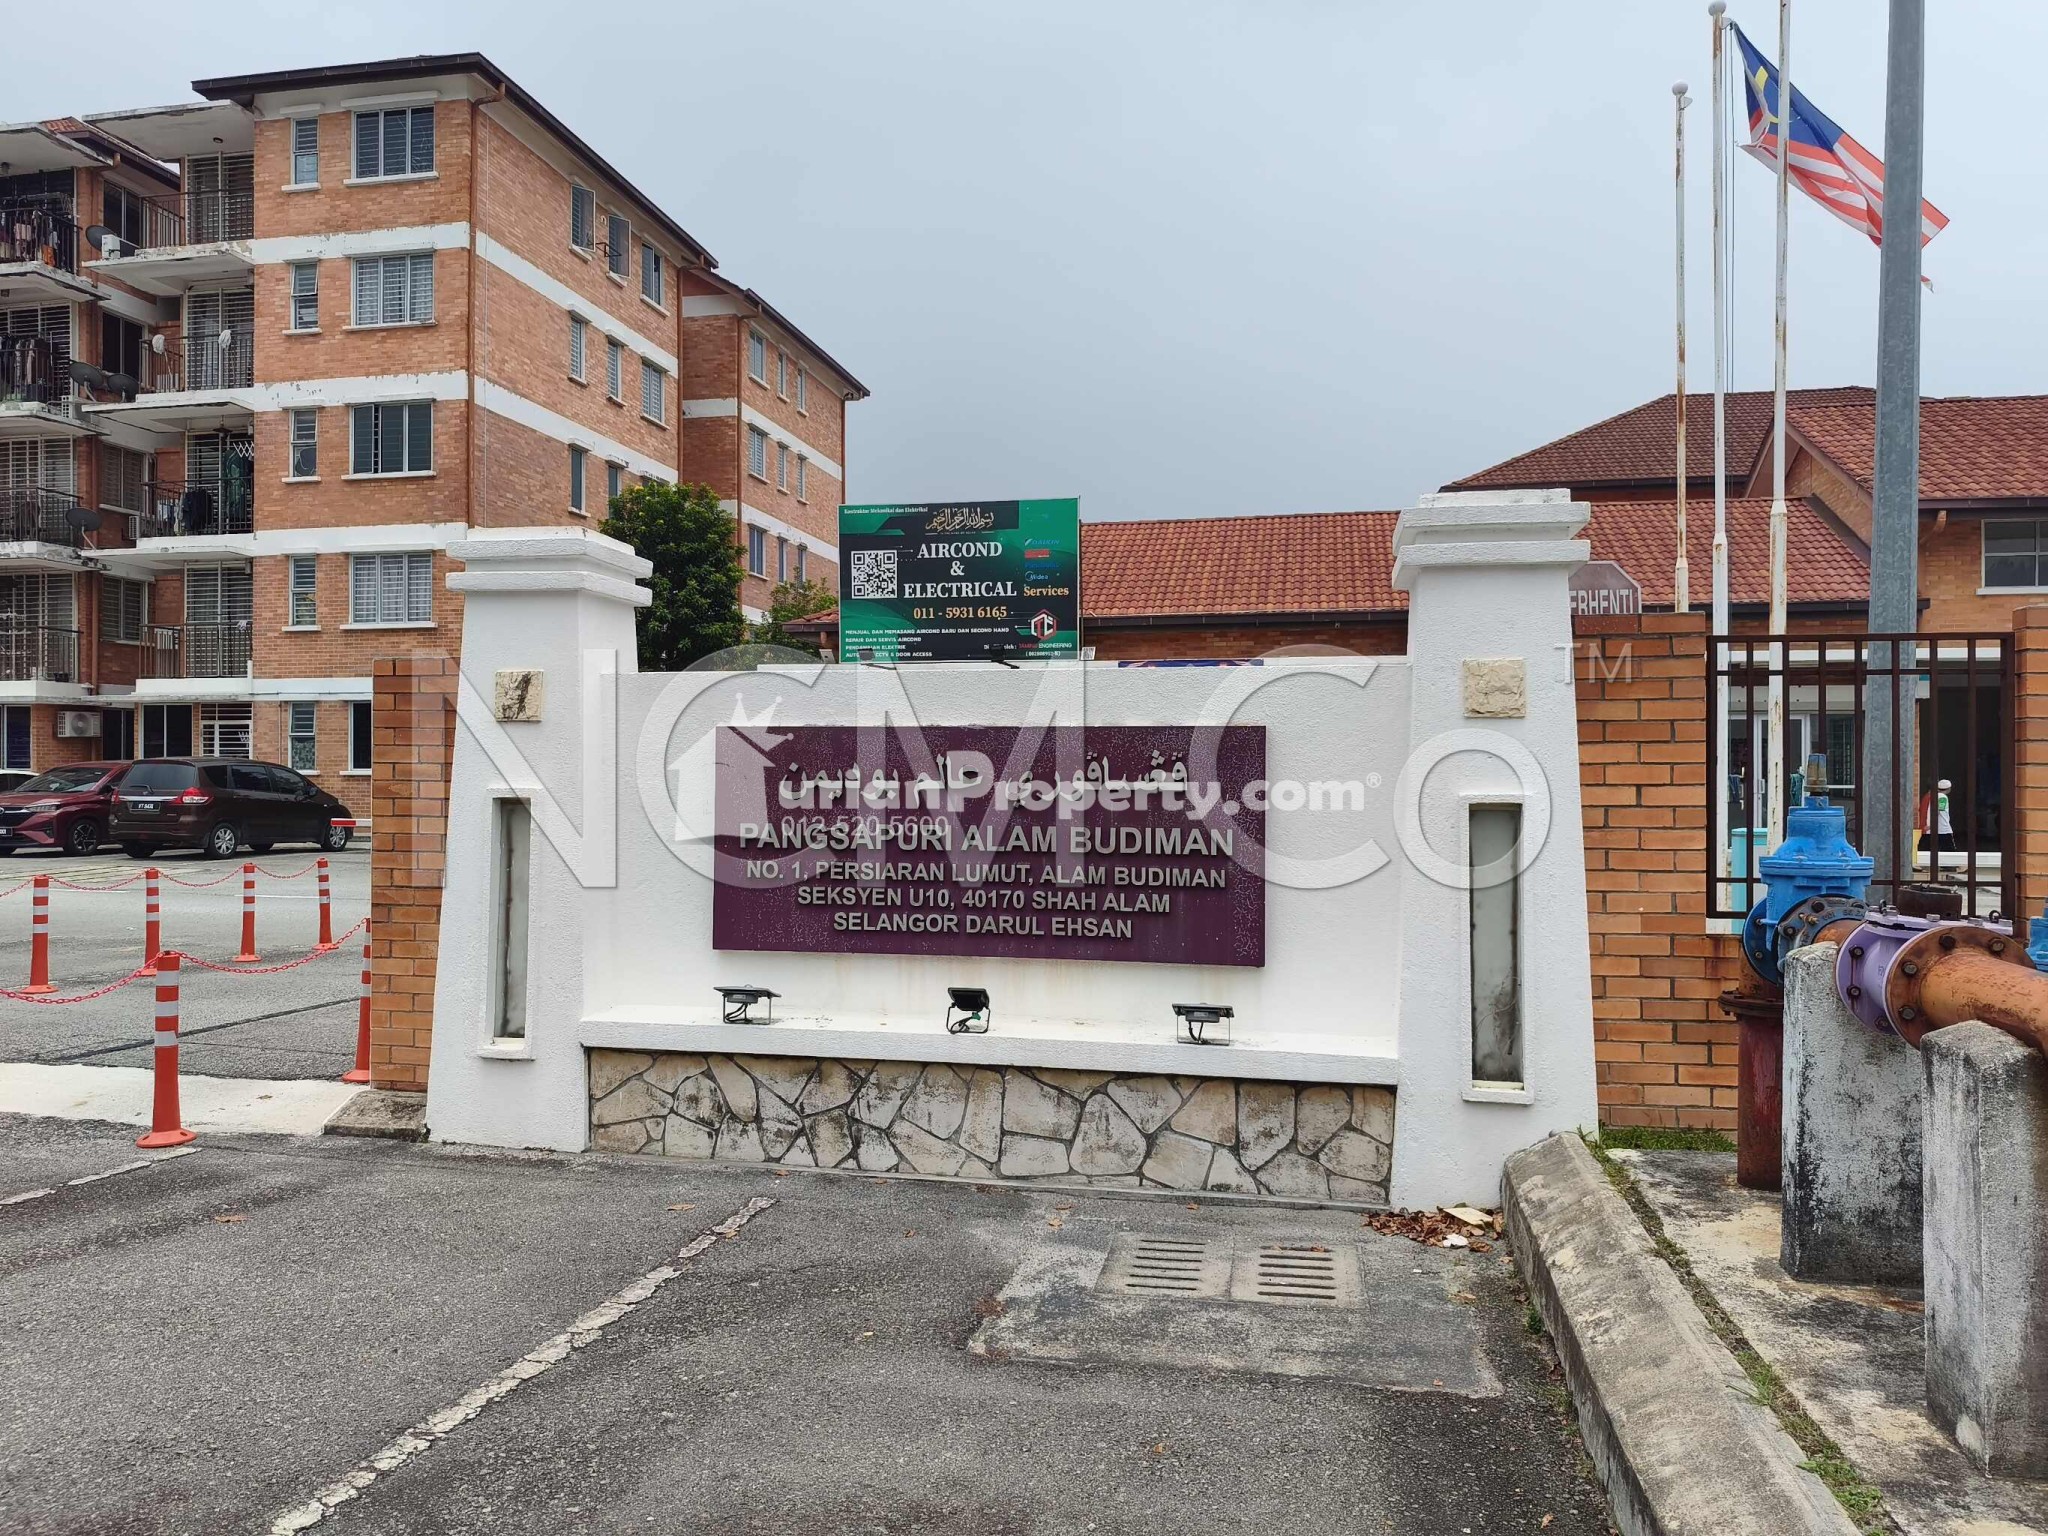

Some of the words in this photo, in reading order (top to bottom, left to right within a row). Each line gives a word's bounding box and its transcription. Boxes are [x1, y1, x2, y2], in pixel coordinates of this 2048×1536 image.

[917, 541, 1003, 559] AIRCOND
[950, 560, 965, 576] &
[903, 581, 1018, 599] ELECTRICAL
[1023, 585, 1069, 597] Services
[913, 607, 935, 619] 011
[946, 606, 975, 619] 5931
[977, 605, 1008, 618] 6165
[1568, 588, 1634, 615] ERHENTI
[739, 822, 951, 851] PANGSAPURI
[961, 824, 1056, 852] ALAM
[1070, 826, 1233, 856] BUDIMAN
[747, 860, 784, 879] NO.
[792, 861, 808, 881] 1,
[815, 861, 944, 881] PERSIARAN
[952, 863, 1034, 885] LUMUT,
[1040, 865, 1105, 885] ALAM
[1114, 866, 1226, 888] BUDIMAN
[798, 886, 901, 906] SEKSYEN
[909, 888, 955, 910] U10,
[962, 889, 1025, 909] 40170
[1032, 890, 1096, 911] SHAH
[1102, 893, 1170, 913] ALAM
[833, 912, 959, 933] SELANGOR
[966, 915, 1045, 935] DARUL
[1052, 917, 1132, 939] EHSAN
